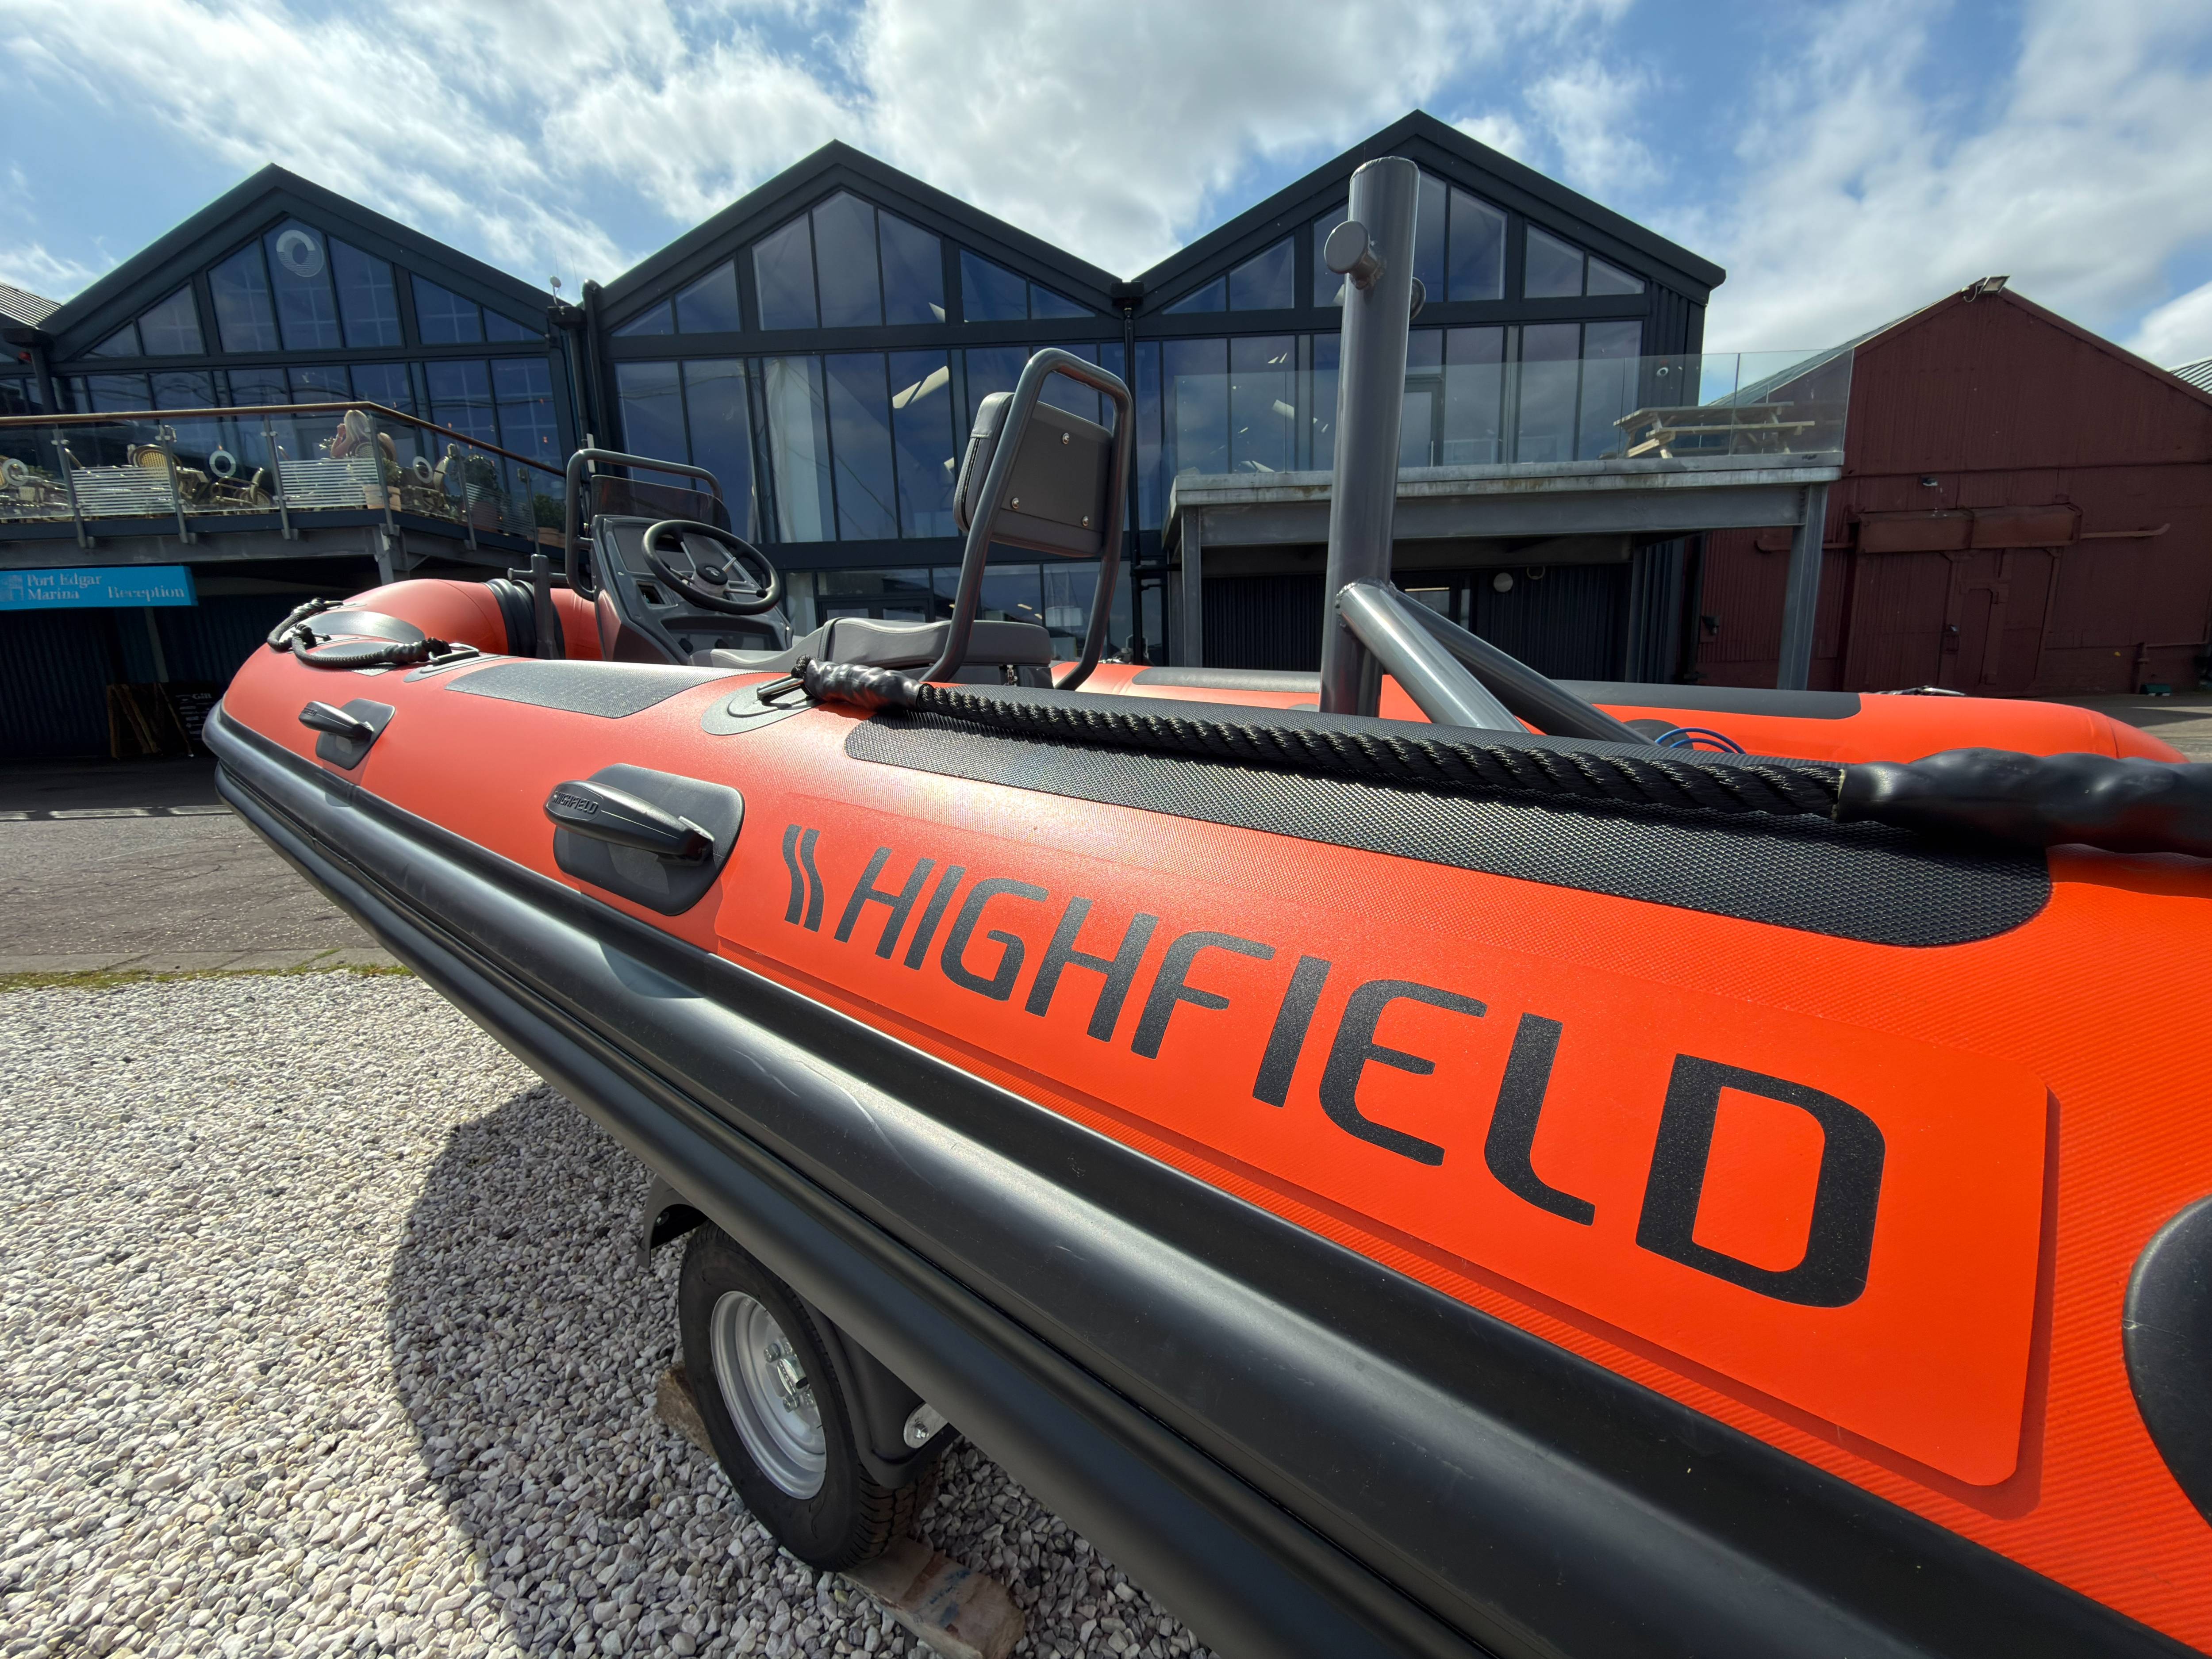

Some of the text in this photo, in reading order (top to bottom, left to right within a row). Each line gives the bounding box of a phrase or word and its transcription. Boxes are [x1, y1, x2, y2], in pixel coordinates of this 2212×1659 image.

[27, 573, 102, 588] Port Edgar
[28, 587, 80, 601] Marina
[108, 585, 185, 602] Reception
[554, 793, 599, 815] HIGHFIELD
[835, 847, 1885, 1307] HIGHFIELD
